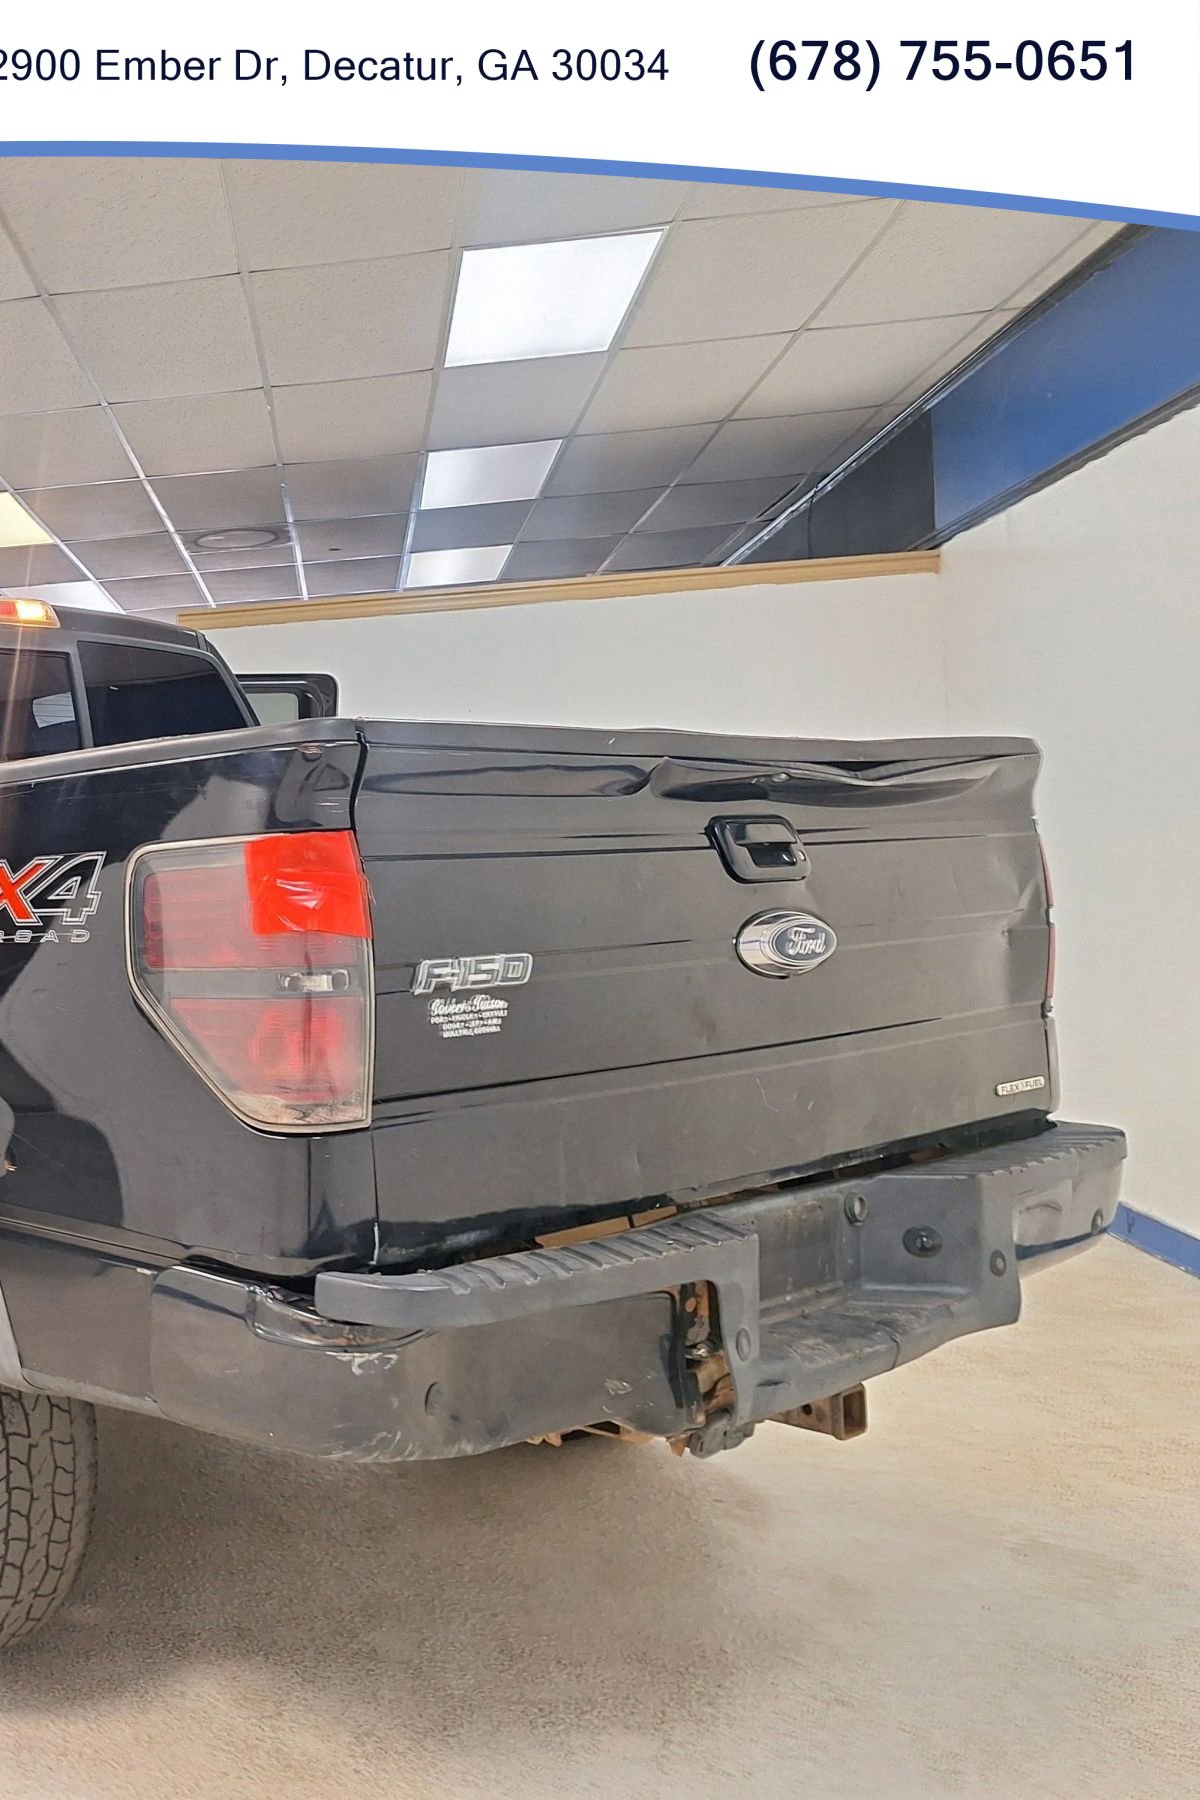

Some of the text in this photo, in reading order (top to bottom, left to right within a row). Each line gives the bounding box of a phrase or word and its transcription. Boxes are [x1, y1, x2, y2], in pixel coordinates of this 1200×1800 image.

[785, 926, 827, 956] Ford
[1000, 1078, 1043, 1095] FLEX FUEL
